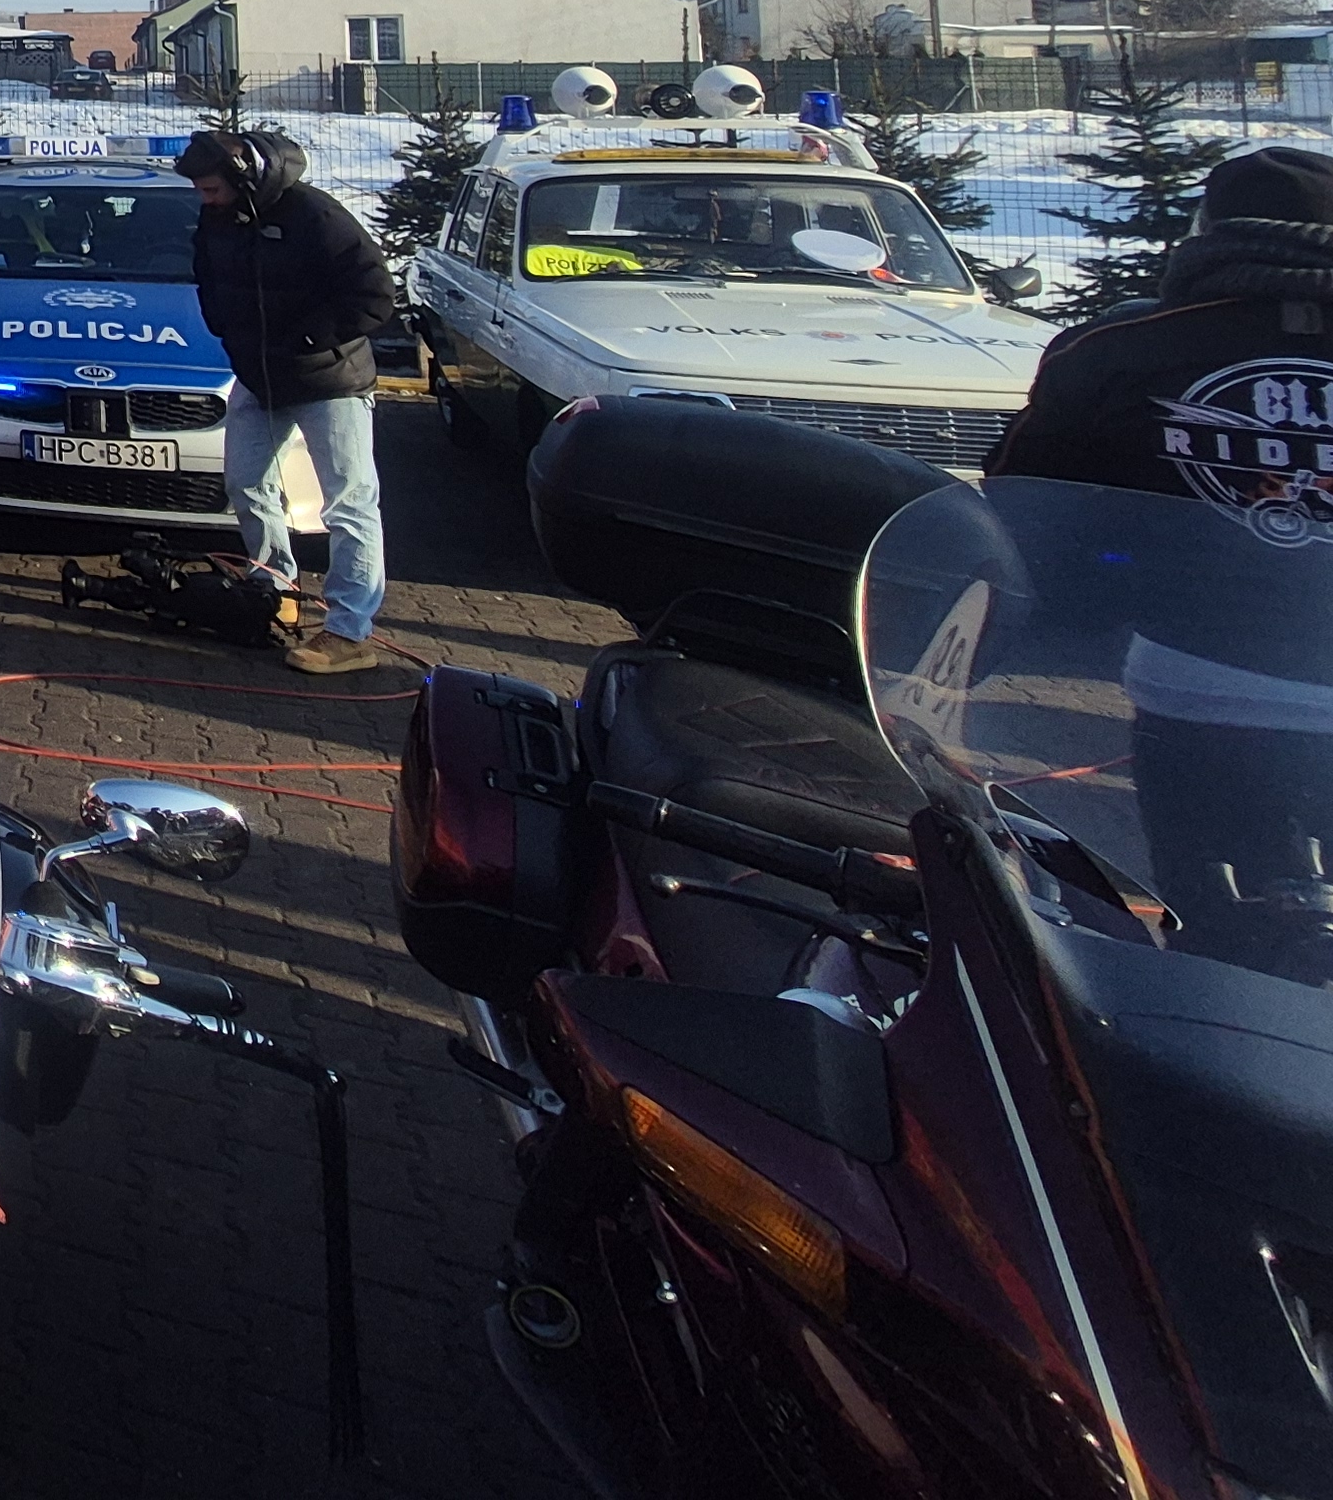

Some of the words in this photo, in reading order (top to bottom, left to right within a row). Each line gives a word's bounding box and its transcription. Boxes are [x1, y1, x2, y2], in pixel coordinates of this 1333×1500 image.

[30, 140, 103, 157] POLICJA
[2, 320, 188, 347] POLICJA
[646, 325, 786, 337] VOLKS
[82, 367, 110, 377] KIA
[39, 436, 96, 464] HPC
[106, 442, 170, 469] B381
